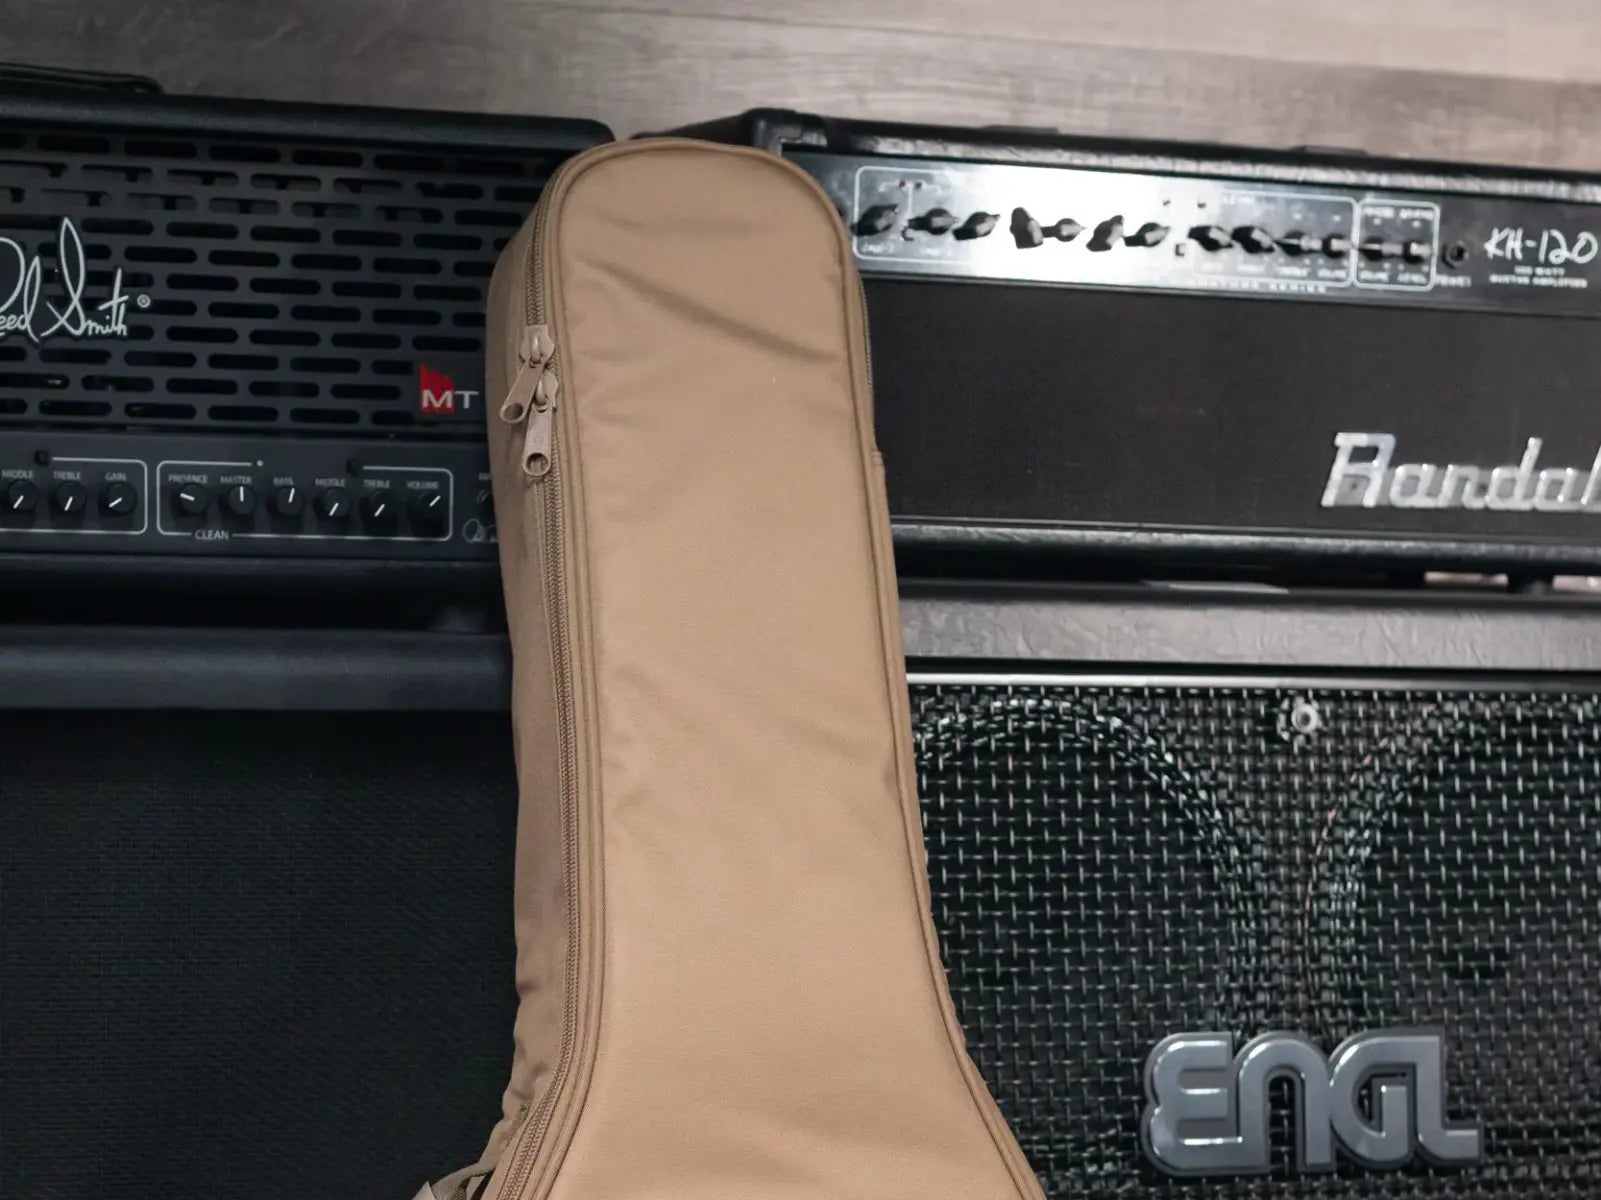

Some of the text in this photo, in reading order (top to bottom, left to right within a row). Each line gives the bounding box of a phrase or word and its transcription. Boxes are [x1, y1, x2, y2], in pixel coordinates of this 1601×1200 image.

[1483, 226, 1599, 265] KH-120
[40, 216, 130, 337] Smith
[421, 389, 480, 409] MT
[194, 529, 230, 541] CLEAN
[1141, 1029, 1484, 1177] ENGL
